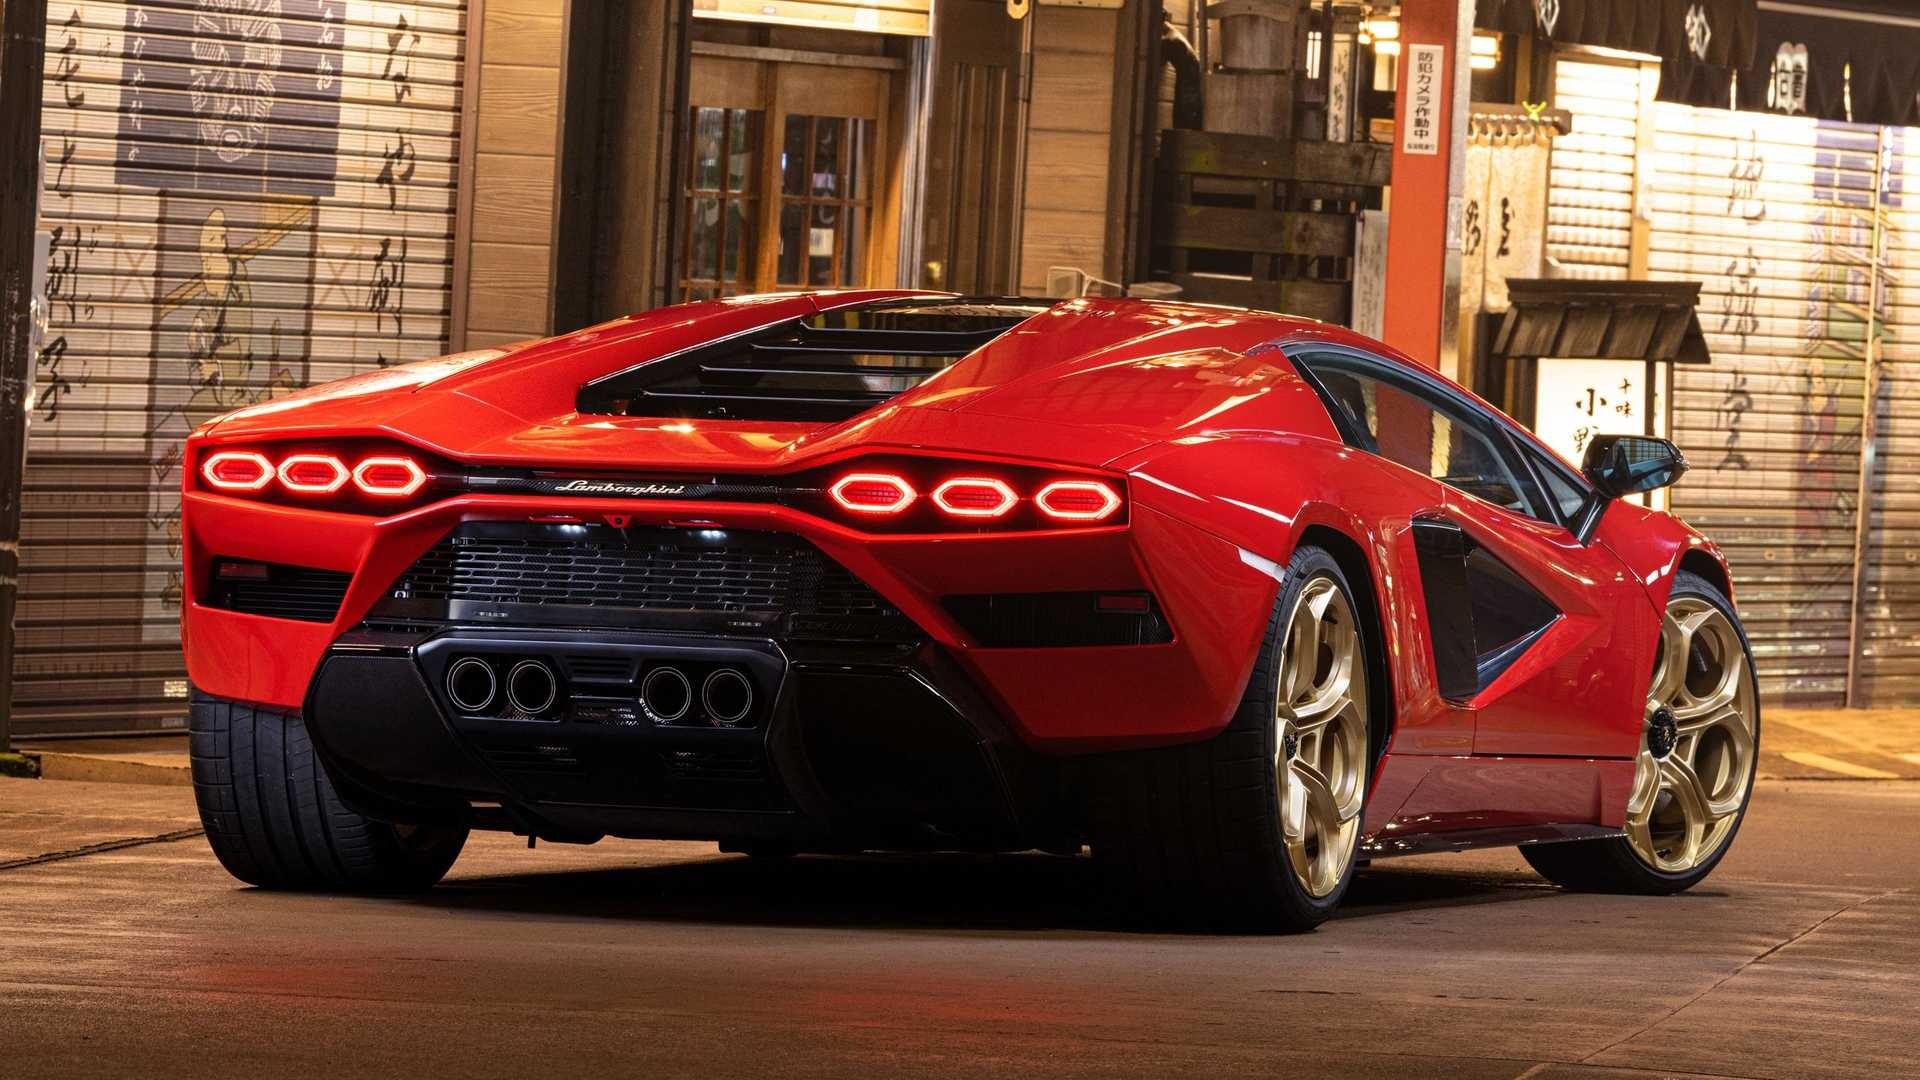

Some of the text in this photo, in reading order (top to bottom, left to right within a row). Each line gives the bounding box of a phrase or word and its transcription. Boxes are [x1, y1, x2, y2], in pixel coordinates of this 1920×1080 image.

[1414, 52, 1434, 139] 防犯カメラ作動中
[1614, 377, 1635, 418] 十味
[555, 480, 686, 496] Lamborghini
